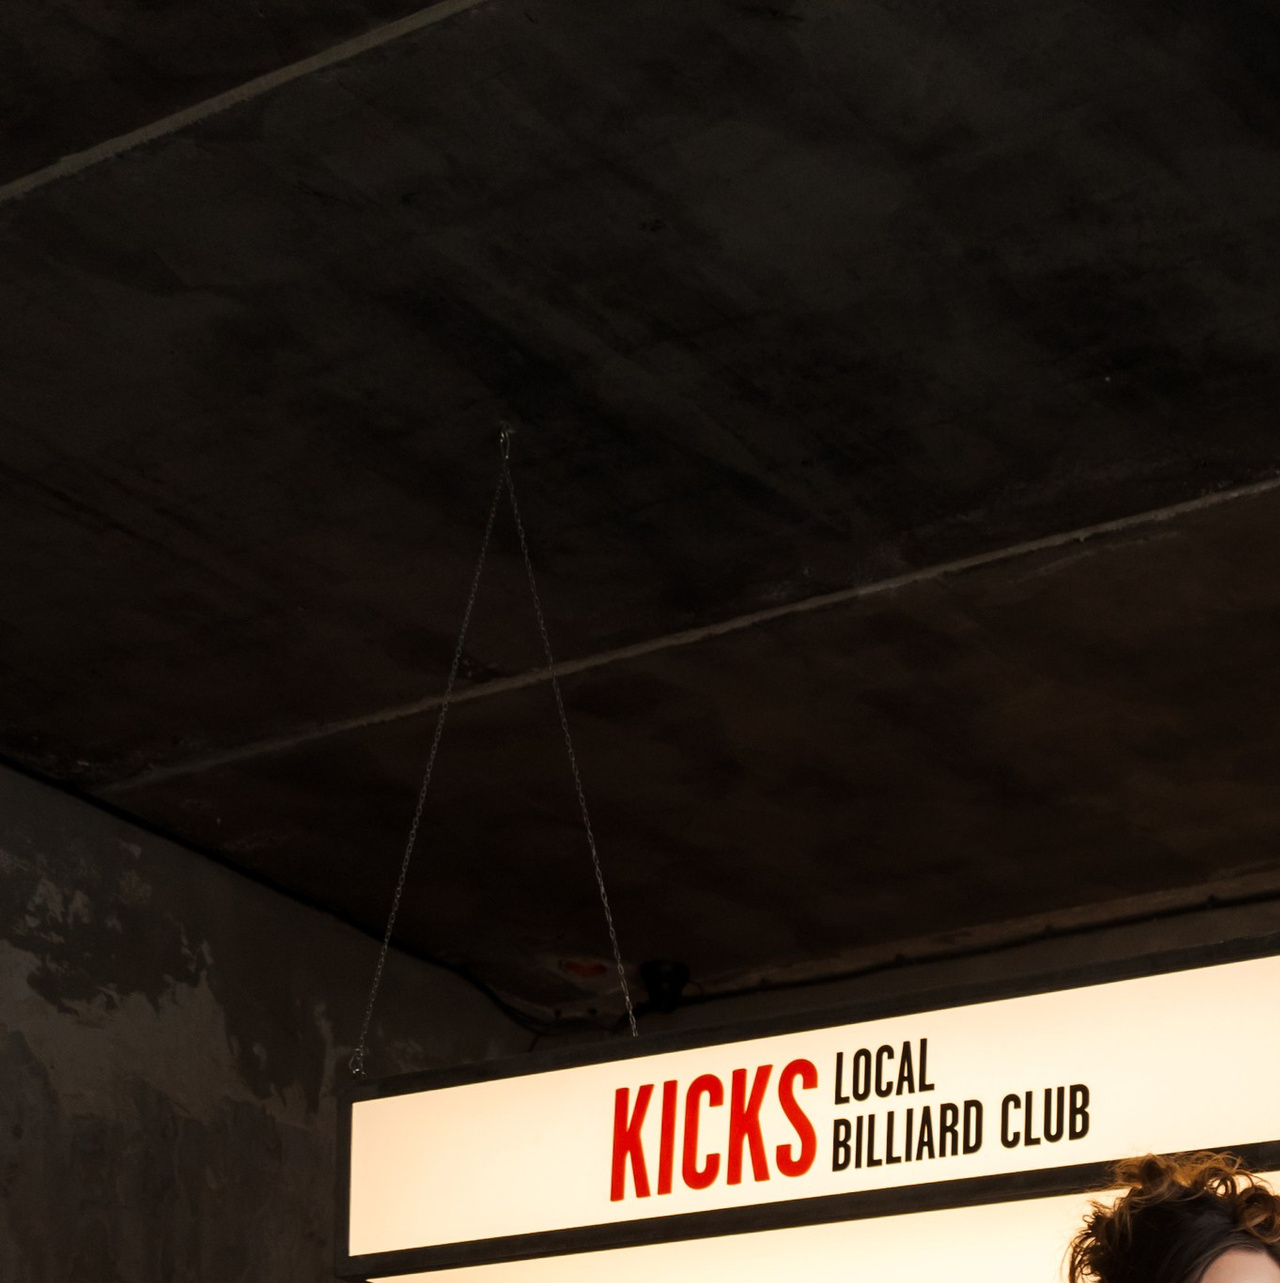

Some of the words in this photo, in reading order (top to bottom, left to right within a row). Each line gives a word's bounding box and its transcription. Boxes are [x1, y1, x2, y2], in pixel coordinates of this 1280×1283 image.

[834, 1038, 935, 1105] LOCAL
[610, 1058, 818, 1202] KICKS
[831, 1099, 983, 1172] BILLIARD
[1000, 1084, 1090, 1149] CLUB
